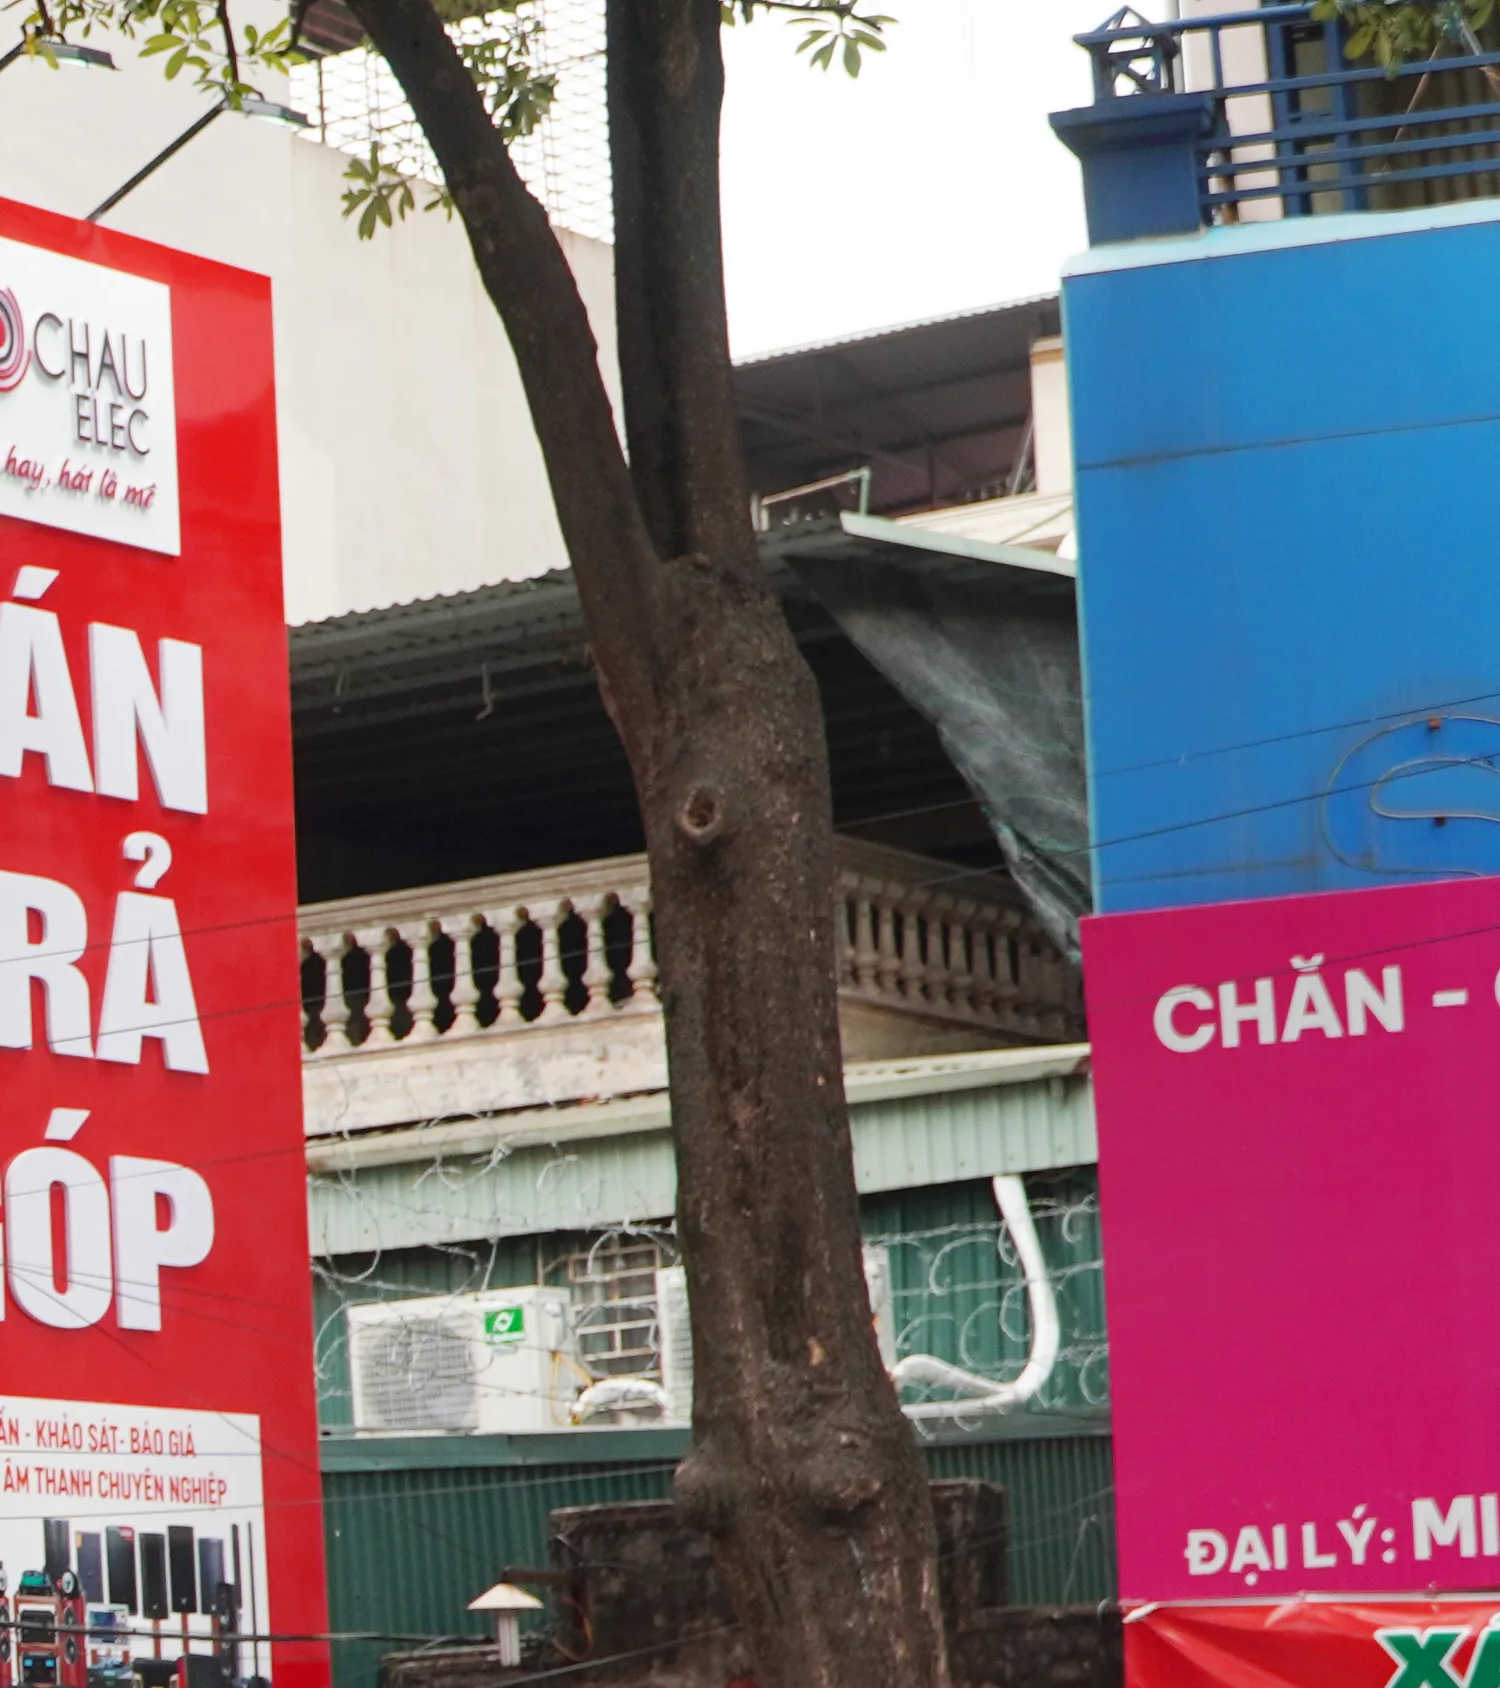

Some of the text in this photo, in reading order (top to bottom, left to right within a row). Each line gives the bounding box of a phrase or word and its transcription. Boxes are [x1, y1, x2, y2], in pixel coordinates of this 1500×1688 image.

[1153, 954, 1404, 1054] CHĂN
[36, 1415, 84, 1453] KHẢO
[129, 1424, 164, 1457] BÁO
[169, 1426, 197, 1459] GIÁ
[3, 1459, 30, 1494] ÂM
[35, 1467, 93, 1498] THANH
[97, 1467, 164, 1503] CHUYÊN
[169, 1470, 227, 1511] NGHIỆP
[1183, 1525, 1288, 1587] ĐẠI
